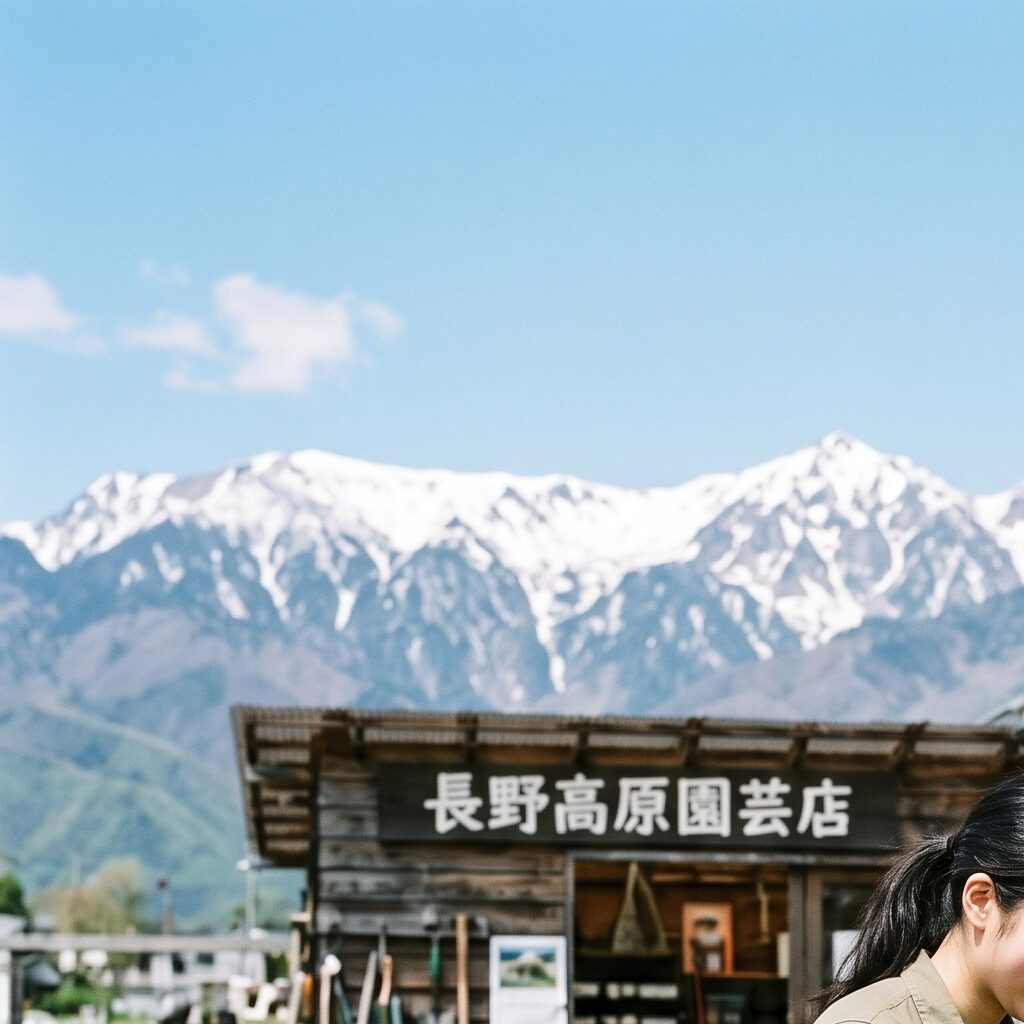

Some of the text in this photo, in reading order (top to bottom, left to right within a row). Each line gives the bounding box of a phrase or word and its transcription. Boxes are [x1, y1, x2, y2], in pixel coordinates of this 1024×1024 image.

[423, 772, 852, 839] 長野高原園芸店
